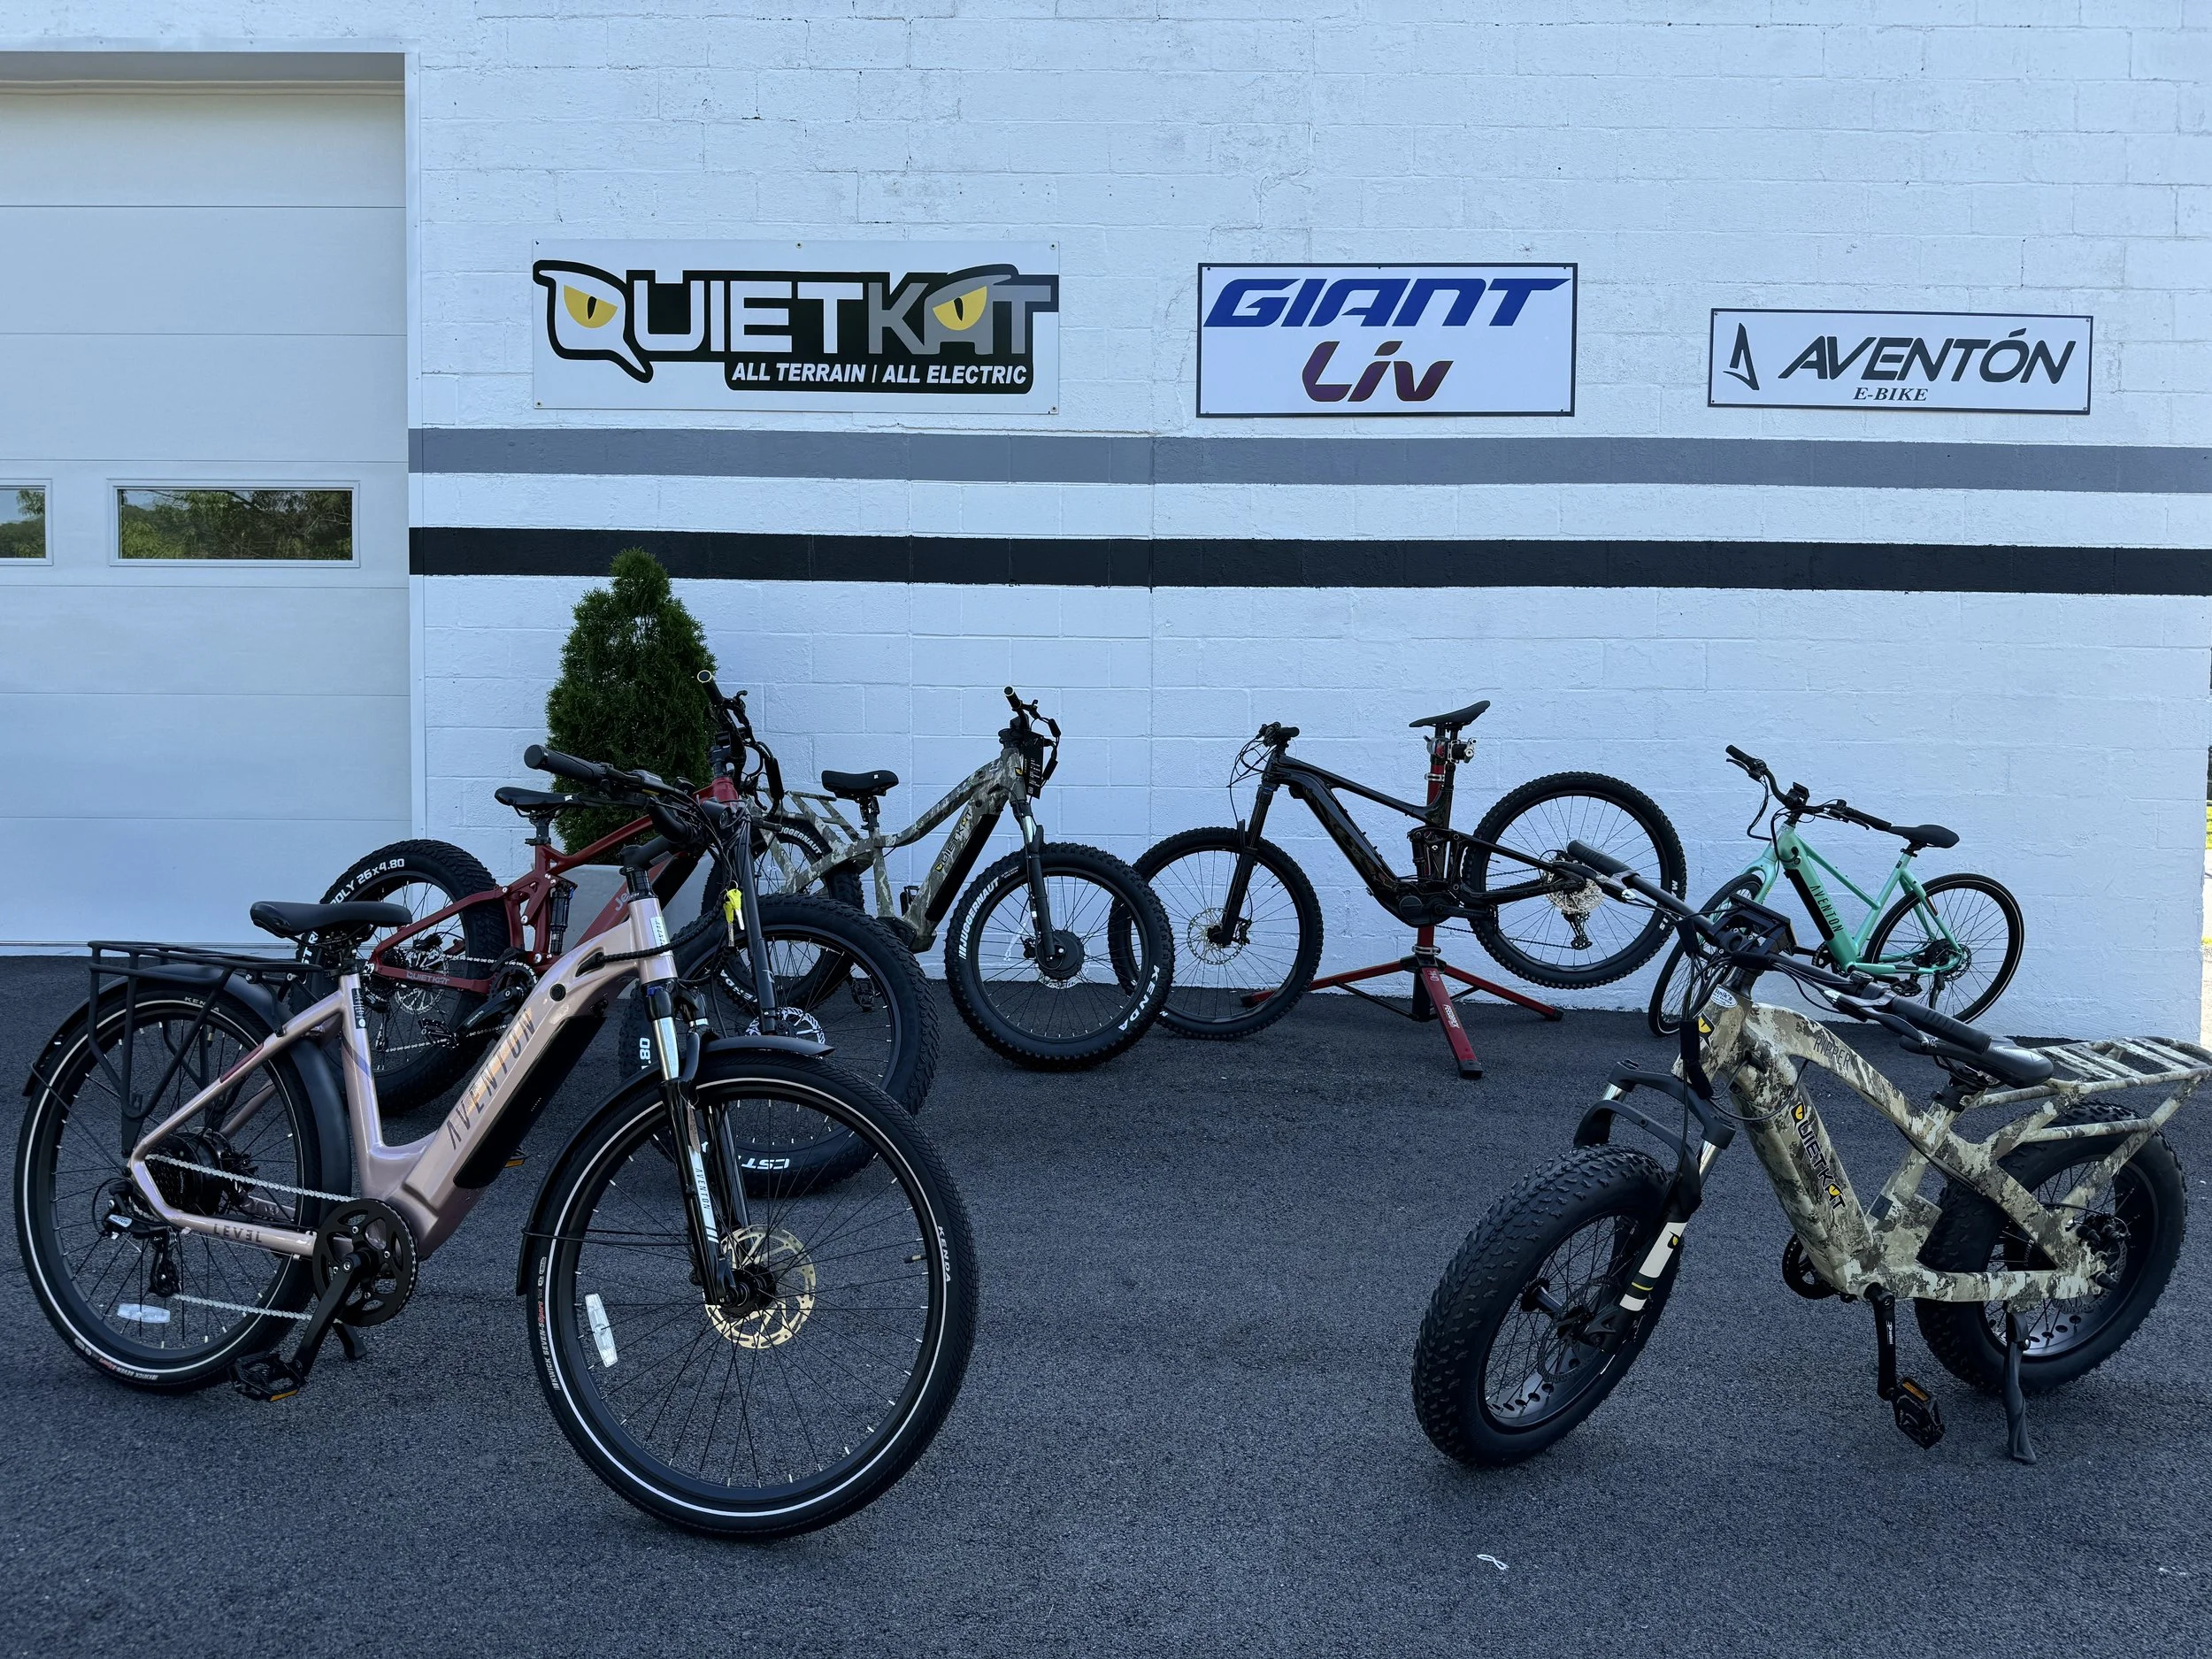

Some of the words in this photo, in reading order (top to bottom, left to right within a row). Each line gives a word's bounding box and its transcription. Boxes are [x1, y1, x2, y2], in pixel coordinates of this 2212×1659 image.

[533, 260, 1059, 383] QUIETKAT
[1203, 278, 1571, 327] GIANT
[732, 362, 771, 381] ALL
[776, 363, 866, 382] TERRAIN
[882, 365, 920, 383] ALL
[926, 365, 1026, 384] ELECTRIC
[1302, 341, 1454, 402] Liv
[1778, 327, 2077, 385] AVENTÓN
[1853, 387, 1928, 402] E-BIKE
[357, 858, 405, 885] 26x4.80
[959, 877, 1001, 949] JUGGERNAUT
[1809, 885, 1845, 933] AVENTON
[406, 971, 450, 985] QUIETKAT
[1118, 964, 1160, 1031] KENDA
[184, 996, 219, 1012] KENA
[1813, 1035, 1852, 1067] RIPPER
[741, 1158, 790, 1170] CST
[695, 1167, 710, 1210] AVENTON
[213, 1223, 263, 1243] LEVEL
[938, 1225, 951, 1282] KENDA
